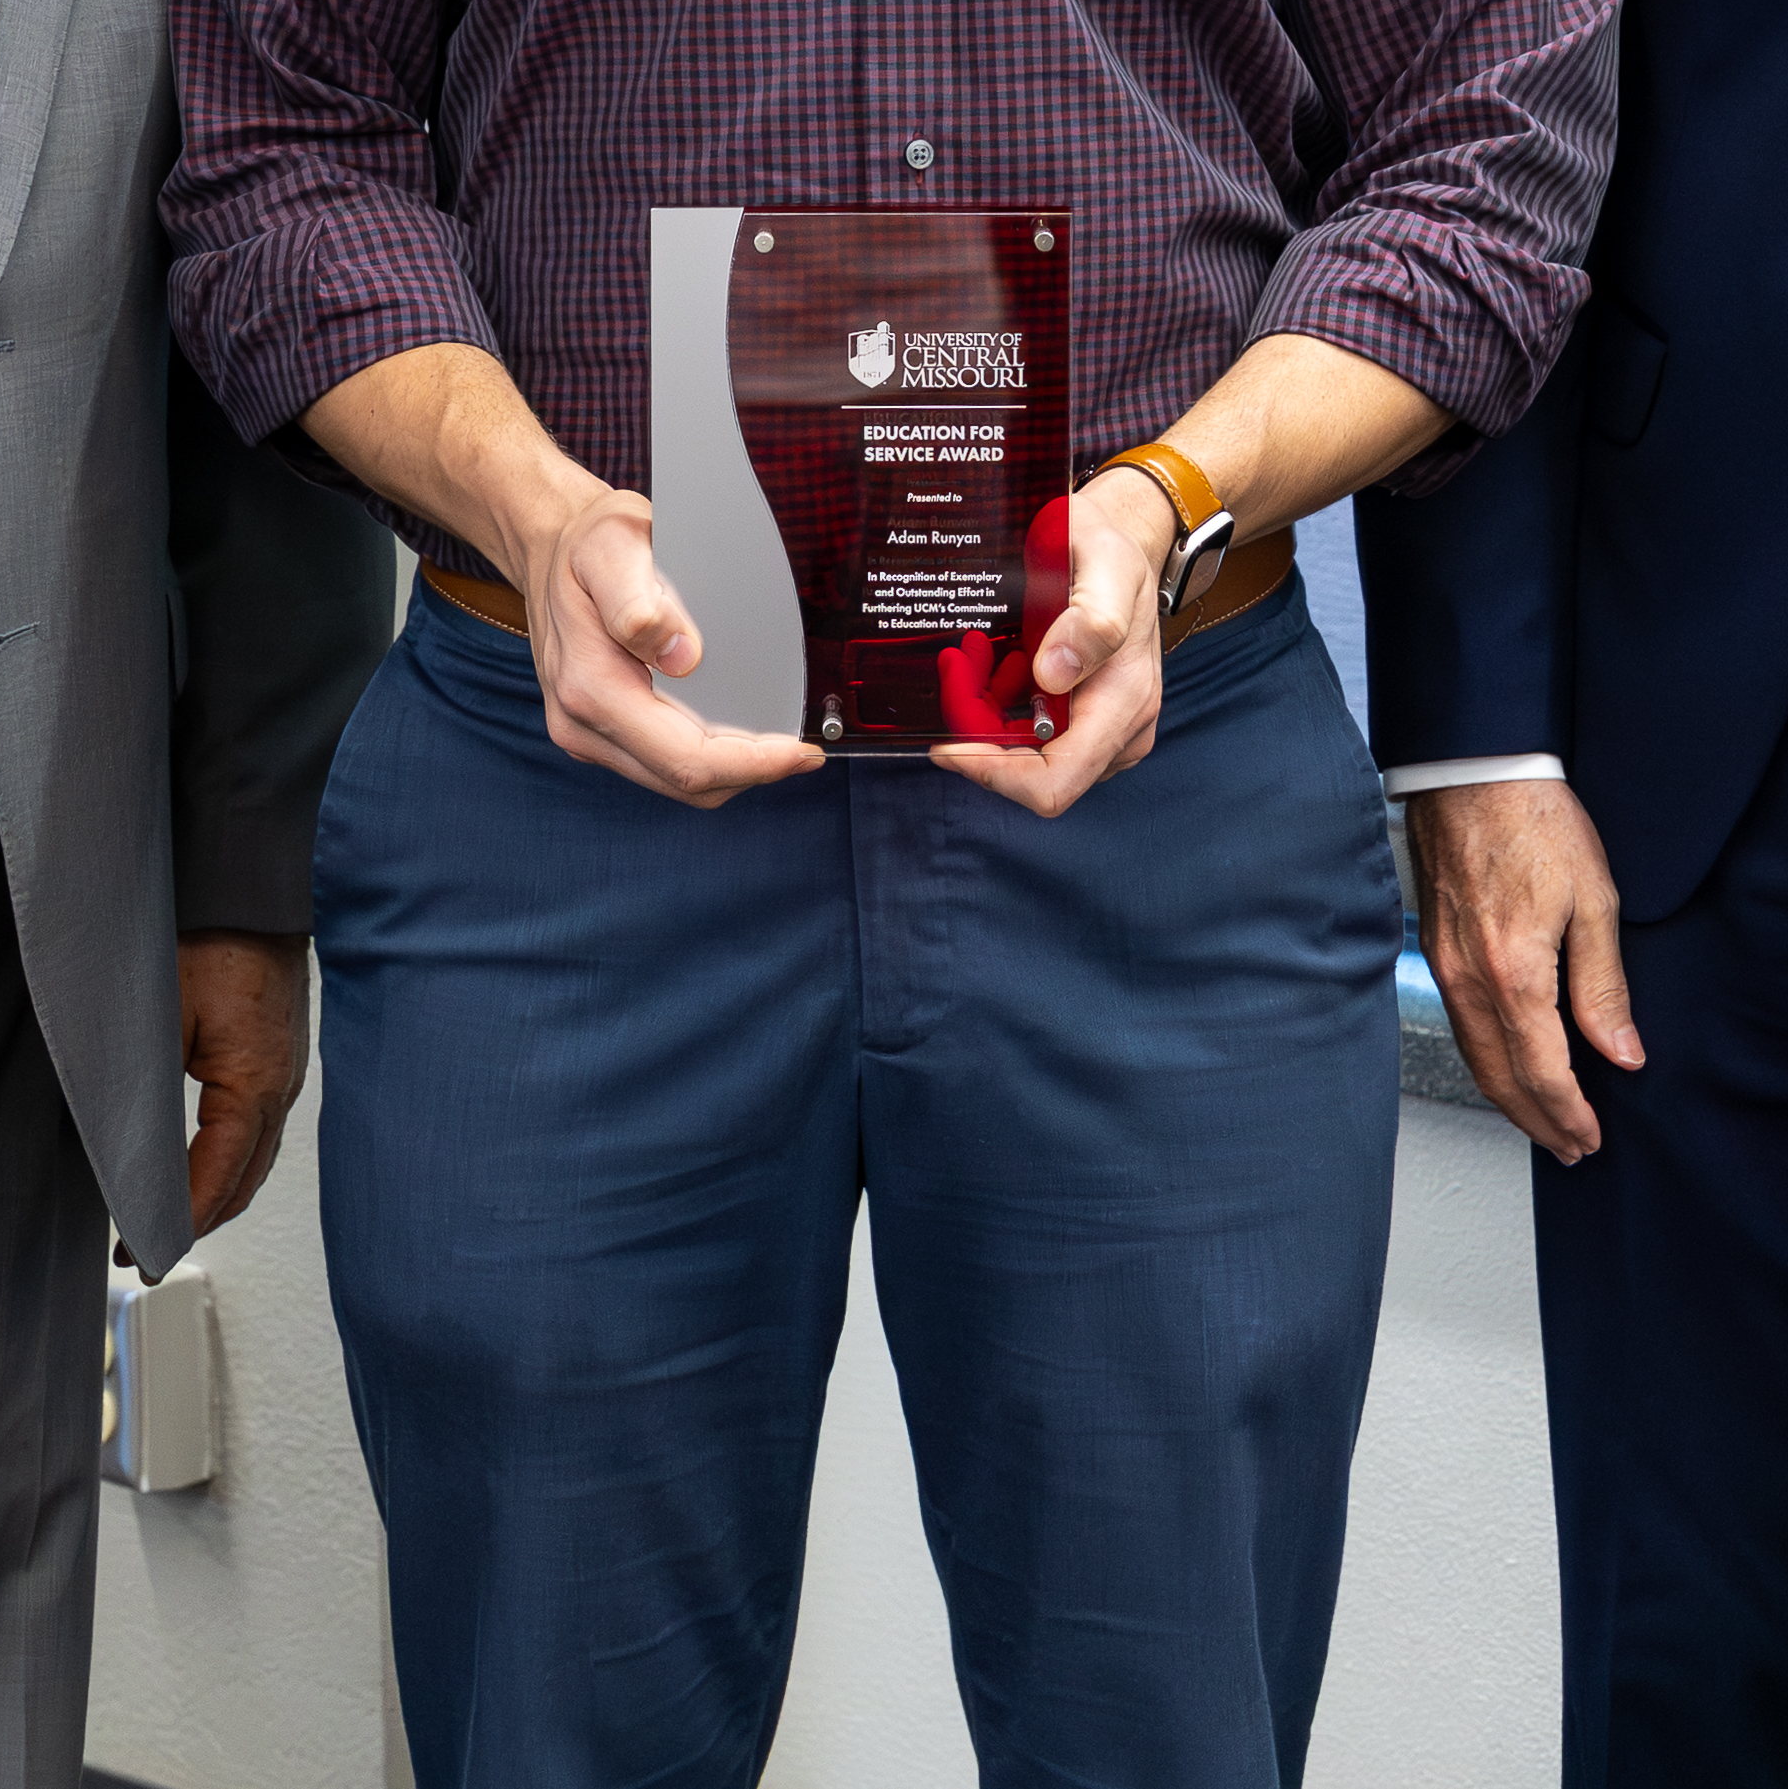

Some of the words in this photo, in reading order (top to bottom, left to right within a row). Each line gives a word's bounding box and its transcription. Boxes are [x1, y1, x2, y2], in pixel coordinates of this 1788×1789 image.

[904, 333, 998, 346] UNIVERSITY
[1000, 333, 1022, 346] OF
[903, 346, 1025, 370] CENTRAL
[901, 368, 1026, 388] MISSOURI
[863, 426, 965, 440] EDUCATION
[969, 426, 1005, 440] FOR
[864, 447, 935, 462] SERVICE
[937, 447, 1004, 462] AWARD
[907, 492, 951, 502] Presented
[953, 493, 963, 502] to
[887, 530, 927, 544] Adam
[931, 530, 981, 548] Runyan
[867, 572, 877, 582] In
[879, 571, 936, 584] Recognition
[937, 571, 949, 582] of
[951, 571, 1003, 584] Exemplary
[875, 586, 894, 597] and
[895, 586, 955, 600] Outstanding
[957, 586, 984, 597] Effort
[985, 587, 995, 597] in
[862, 602, 912, 615] Furthering
[913, 603, 945, 613] UCM's
[947, 603, 1008, 613] Commitment
[878, 620, 889, 628] to
[891, 618, 939, 628] Education
[939, 618, 955, 628] for
[955, 618, 991, 629] Service
